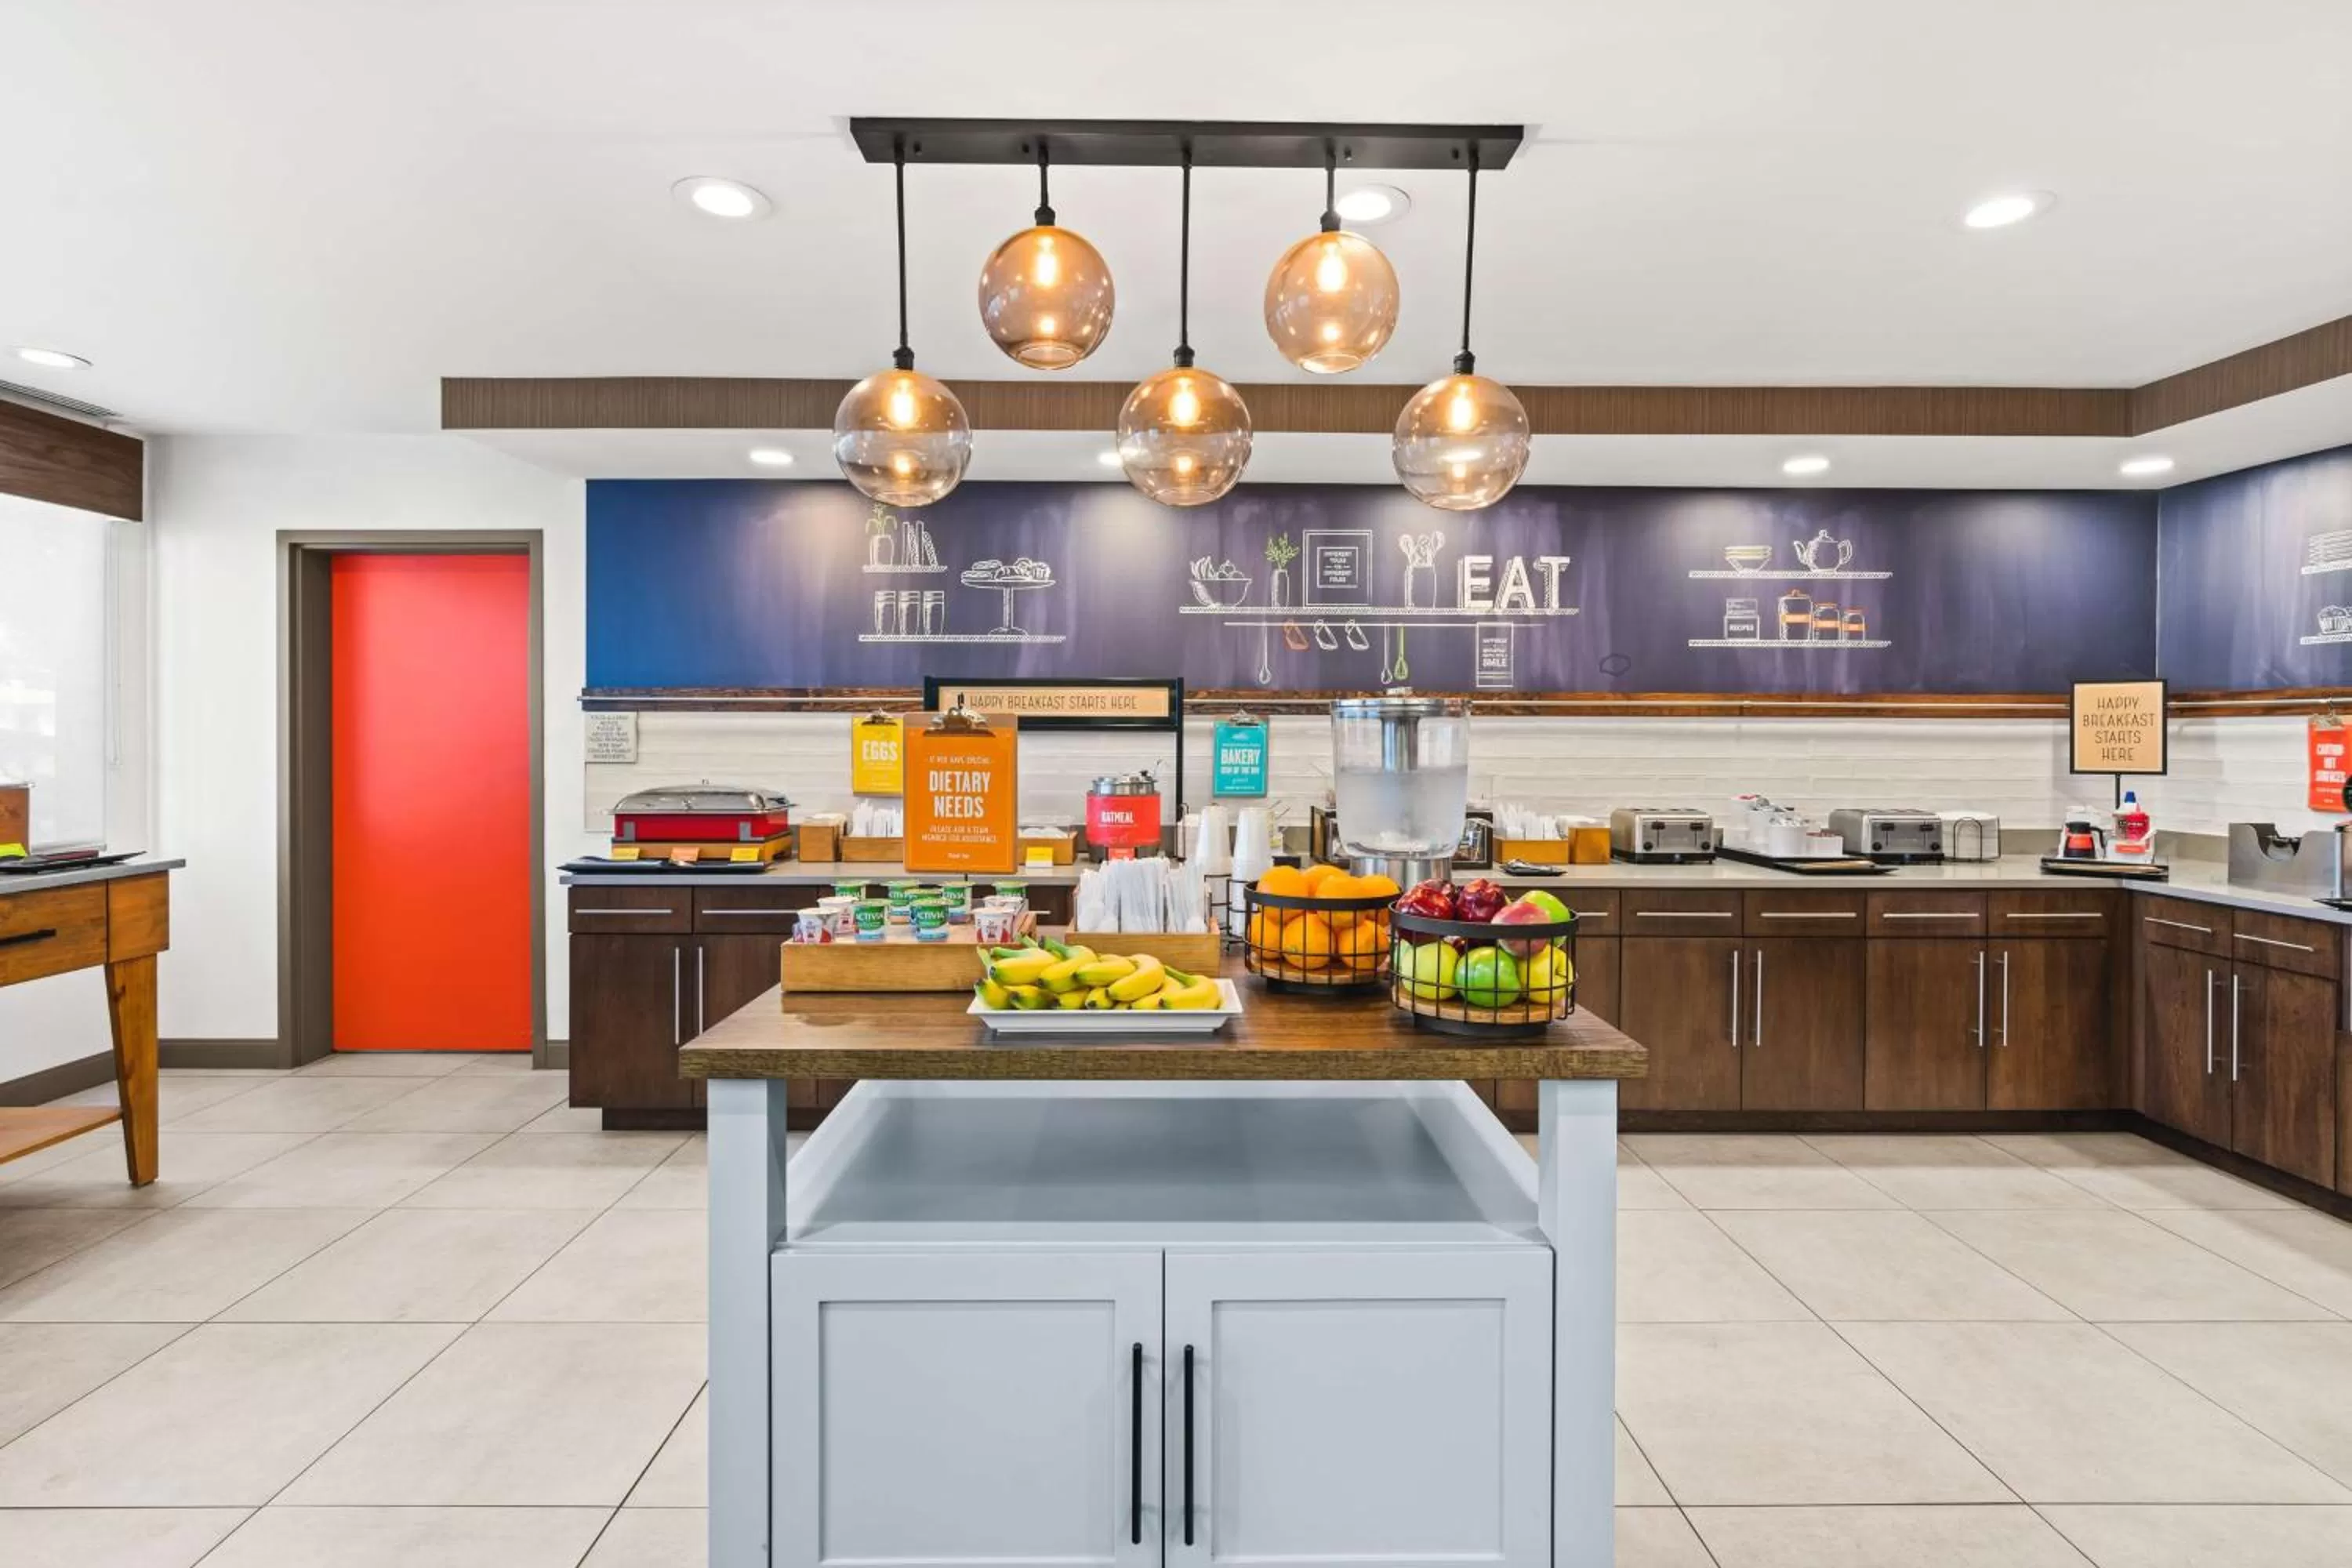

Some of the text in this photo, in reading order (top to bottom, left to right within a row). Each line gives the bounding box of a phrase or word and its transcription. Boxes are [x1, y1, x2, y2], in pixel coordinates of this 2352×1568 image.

[1460, 555, 1570, 609] EAT
[970, 695, 1138, 710] HAPPY BREAKFAST STARTS HERE
[2097, 695, 2140, 710] HAPPY
[2082, 713, 2155, 727] BREAKFAST
[2094, 730, 2141, 744] STARTS
[862, 739, 898, 761] EGGS
[1221, 748, 1261, 765] BAKERY
[2101, 747, 2135, 761] HERE
[928, 771, 991, 793] DIETARY
[934, 796, 984, 818] NEEDS
[1102, 811, 1134, 823] OATMEAL
